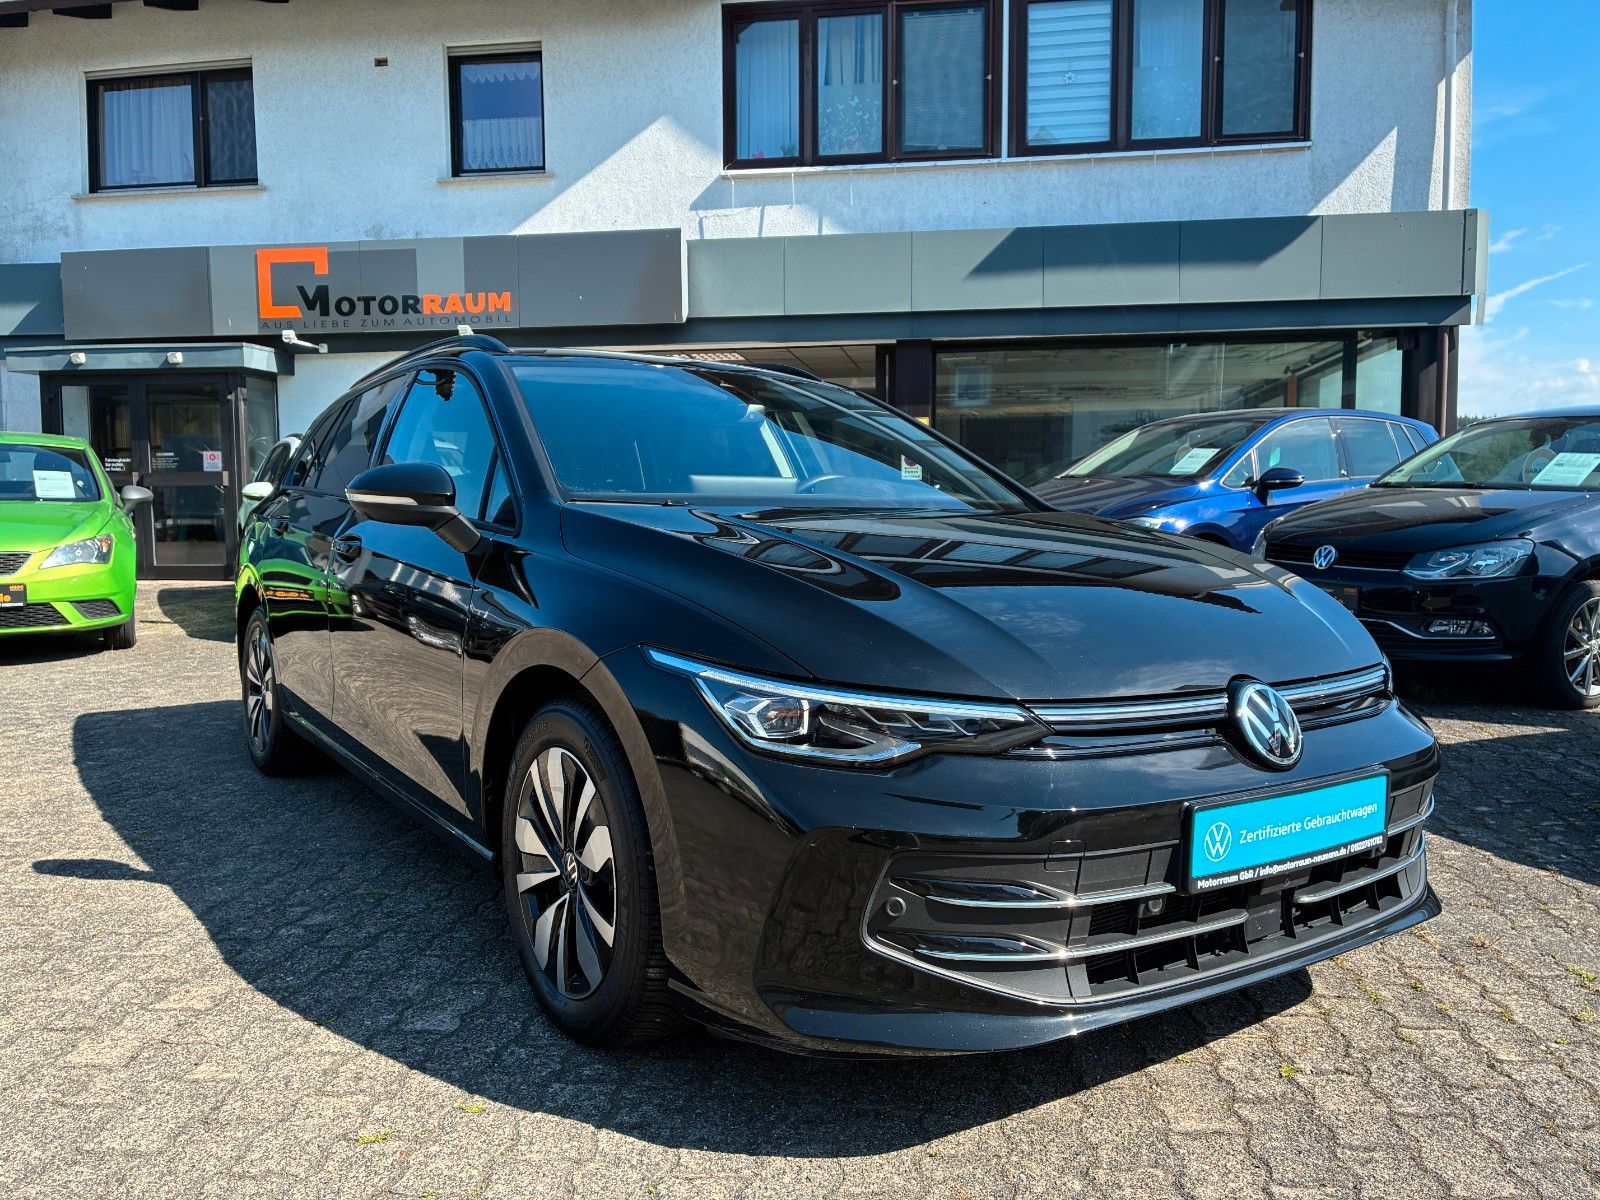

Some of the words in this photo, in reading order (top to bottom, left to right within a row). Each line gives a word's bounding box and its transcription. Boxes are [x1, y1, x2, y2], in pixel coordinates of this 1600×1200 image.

[261, 320, 293, 329] AUS
[303, 319, 350, 329] LIEBE
[360, 318, 395, 327] ZUM
[403, 315, 512, 325] AUTOMOBIL
[1239, 821, 1302, 845] Zertifizierte
[1303, 802, 1378, 831] Gebrauchtwagen
[1197, 873, 1239, 890] Motorraum
[1239, 867, 1254, 880] GbR
